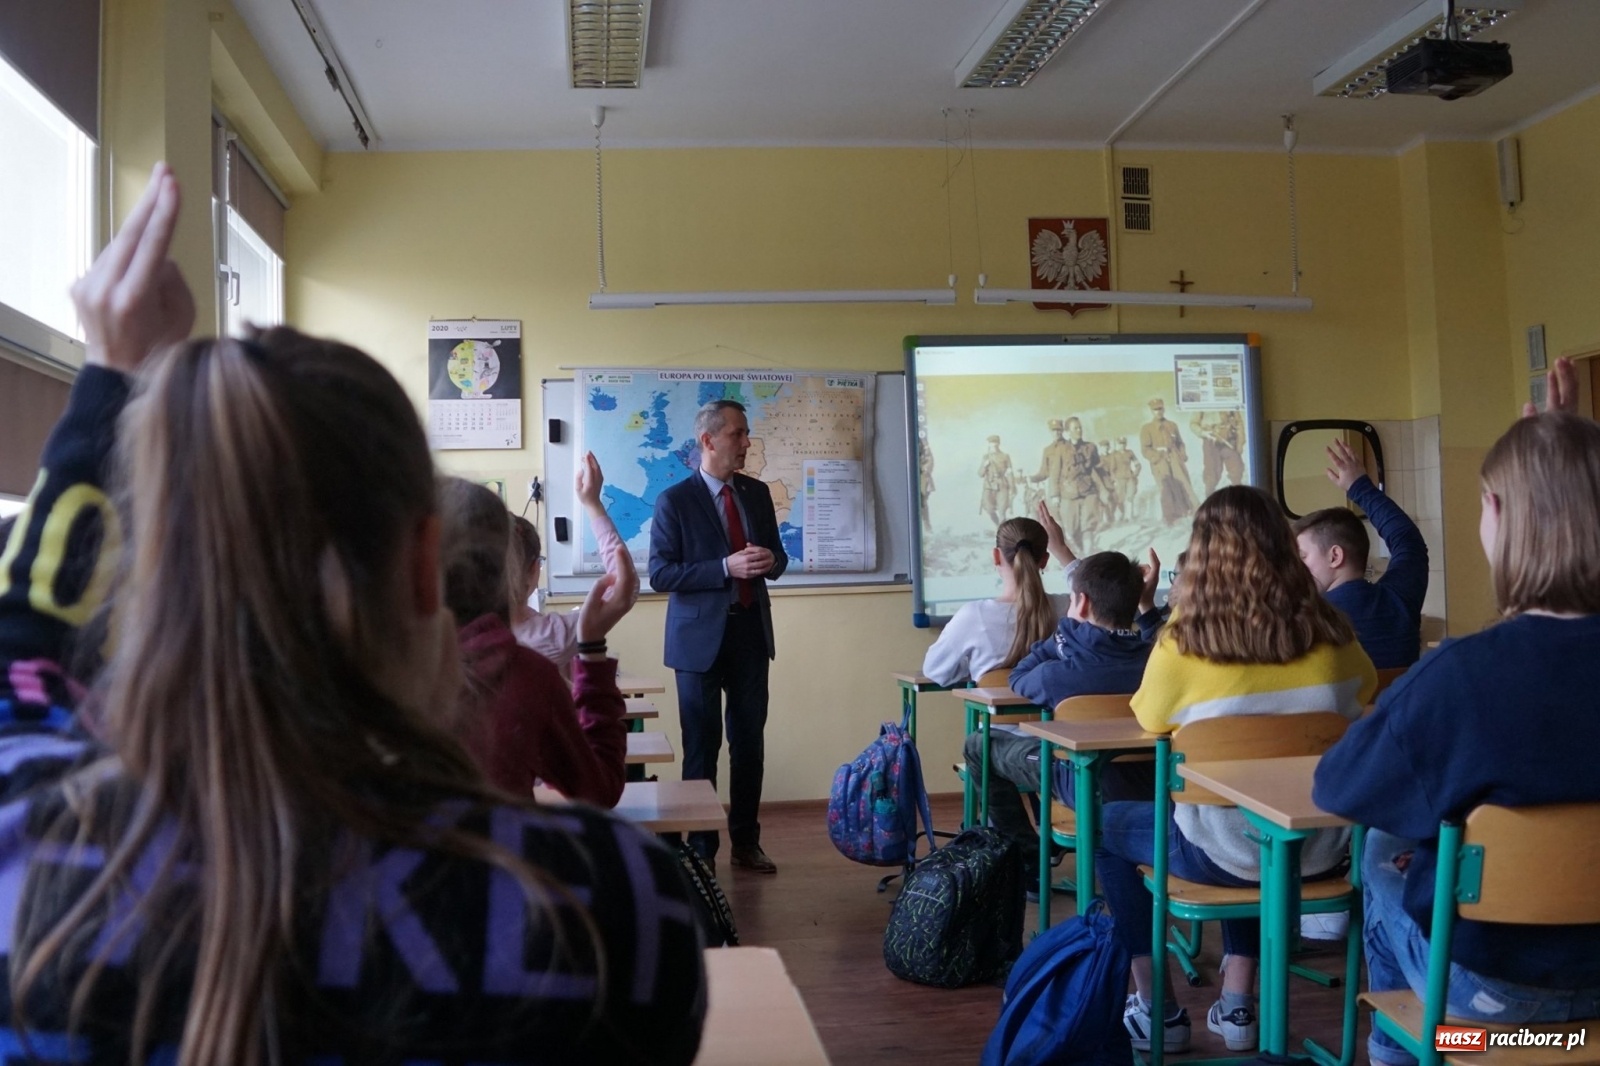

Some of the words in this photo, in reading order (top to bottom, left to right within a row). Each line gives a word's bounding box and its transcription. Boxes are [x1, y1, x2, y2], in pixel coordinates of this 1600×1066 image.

[660, 372, 692, 380] EUROPA
[714, 373, 745, 381] WOJNIE
[747, 373, 793, 382] ŚWIATOWEJ
